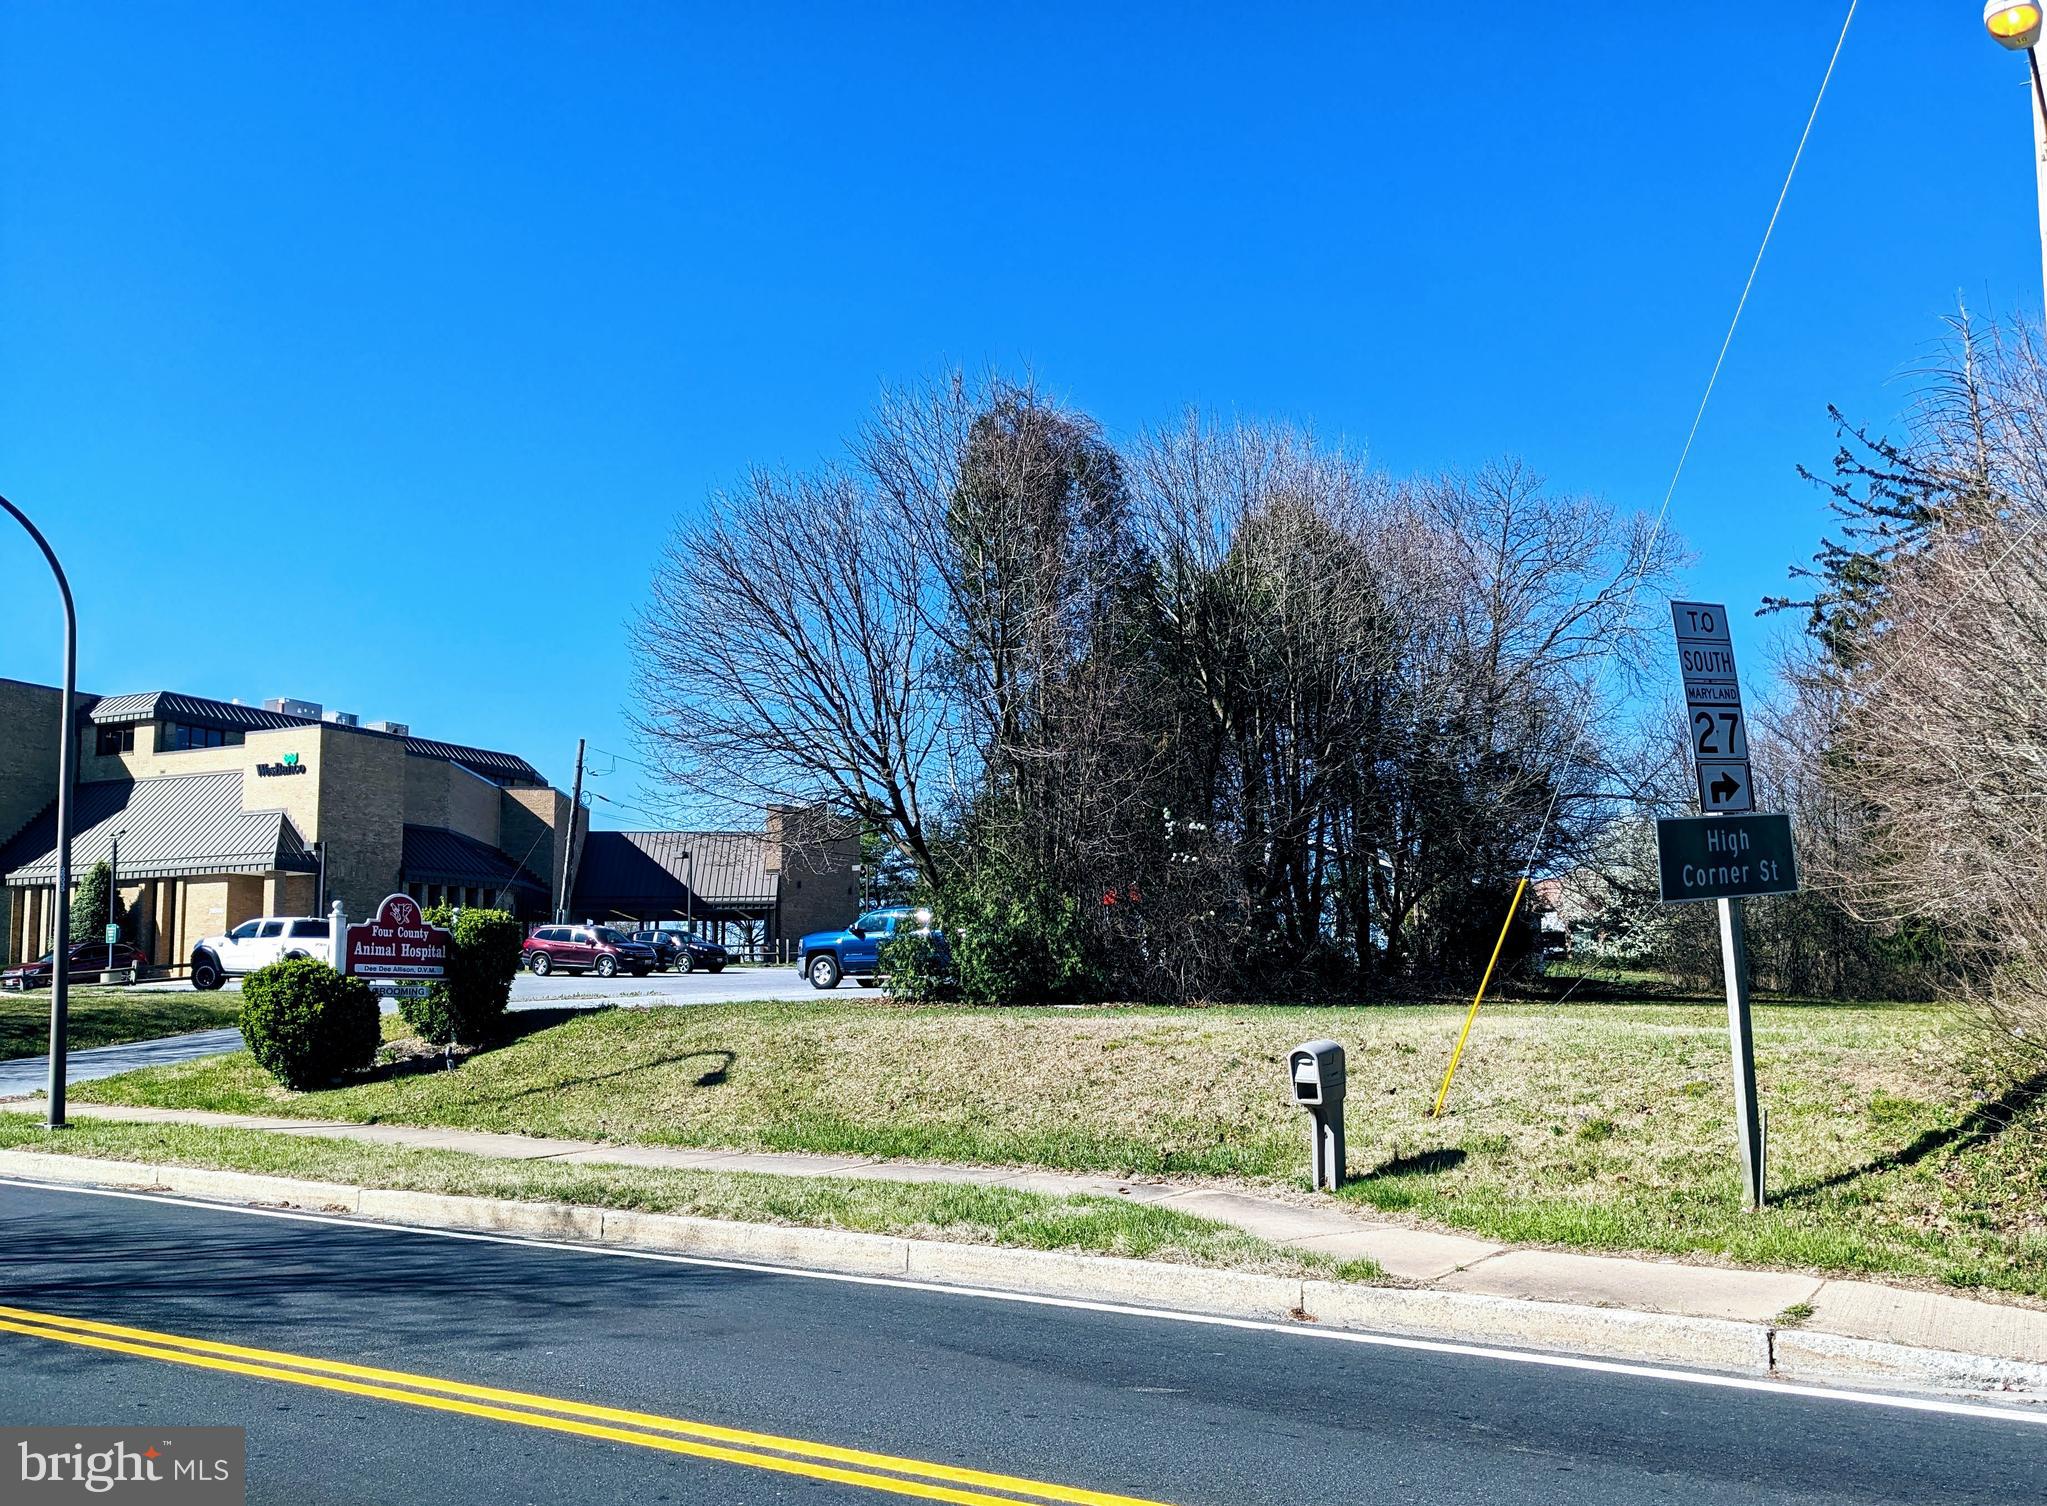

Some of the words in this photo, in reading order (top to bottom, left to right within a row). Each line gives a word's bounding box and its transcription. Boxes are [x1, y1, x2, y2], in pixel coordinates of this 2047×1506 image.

[1686, 610, 1714, 633] TO
[1683, 650, 1732, 674] SOUTH
[1687, 688, 1737, 701] MARYLAND
[1694, 711, 1739, 754] 27
[1706, 828, 1750, 857] High
[1683, 864, 1750, 888] Corner
[1759, 859, 1779, 883] St
[372, 926, 393, 937] Four
[397, 926, 429, 942] County
[354, 941, 396, 957] Animal
[400, 943, 446, 960] Hospital
